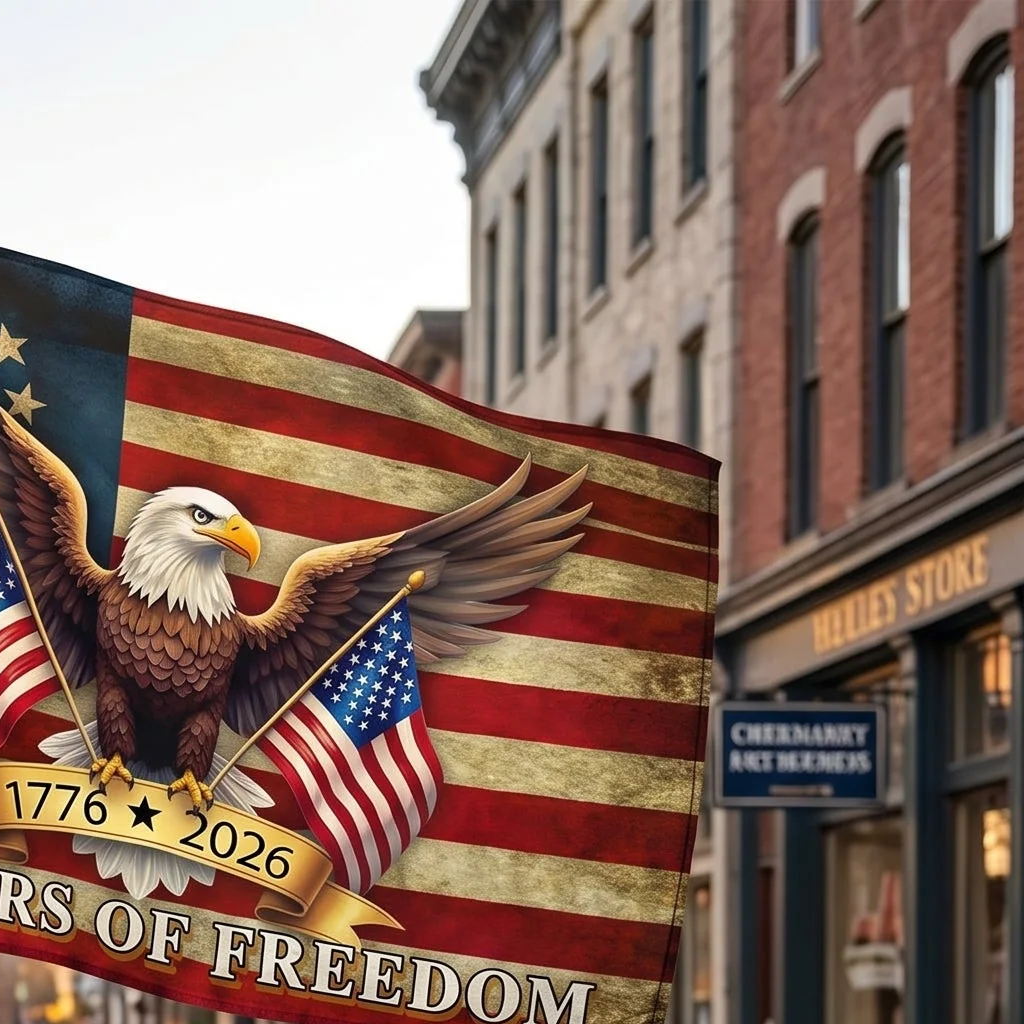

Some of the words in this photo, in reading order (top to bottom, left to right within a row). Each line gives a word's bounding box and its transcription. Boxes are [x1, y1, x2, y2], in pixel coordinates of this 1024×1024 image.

[904, 533, 990, 616] STORE
[5, 780, 108, 826] 1776
[179, 810, 294, 879] 2026
[94, 898, 191, 966] OF
